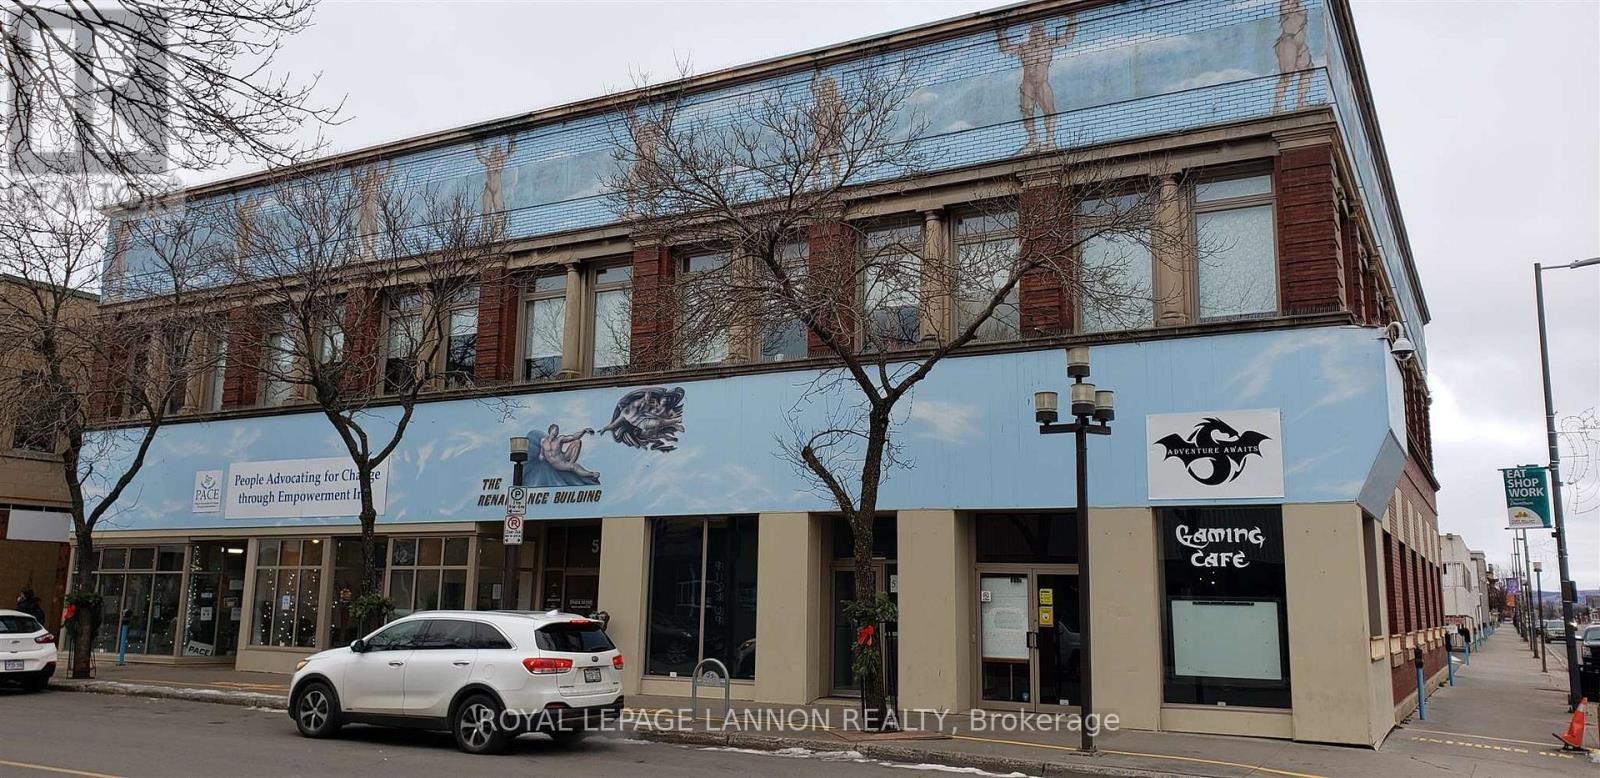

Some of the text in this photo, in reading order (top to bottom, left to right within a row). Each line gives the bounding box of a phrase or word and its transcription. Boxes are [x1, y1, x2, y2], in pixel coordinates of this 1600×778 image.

[1168, 445, 1259, 456] ADVENTURE AWAITS
[235, 468, 381, 489] People Advocating for Chage
[1506, 469, 1527, 478] EAT
[482, 478, 502, 490] THE
[1507, 478, 1539, 488] SHOP
[195, 488, 220, 501] PACE
[238, 491, 275, 506] through
[278, 488, 350, 505] Empowerment
[553, 489, 603, 505] BUILDING
[1508, 487, 1545, 497] WORK
